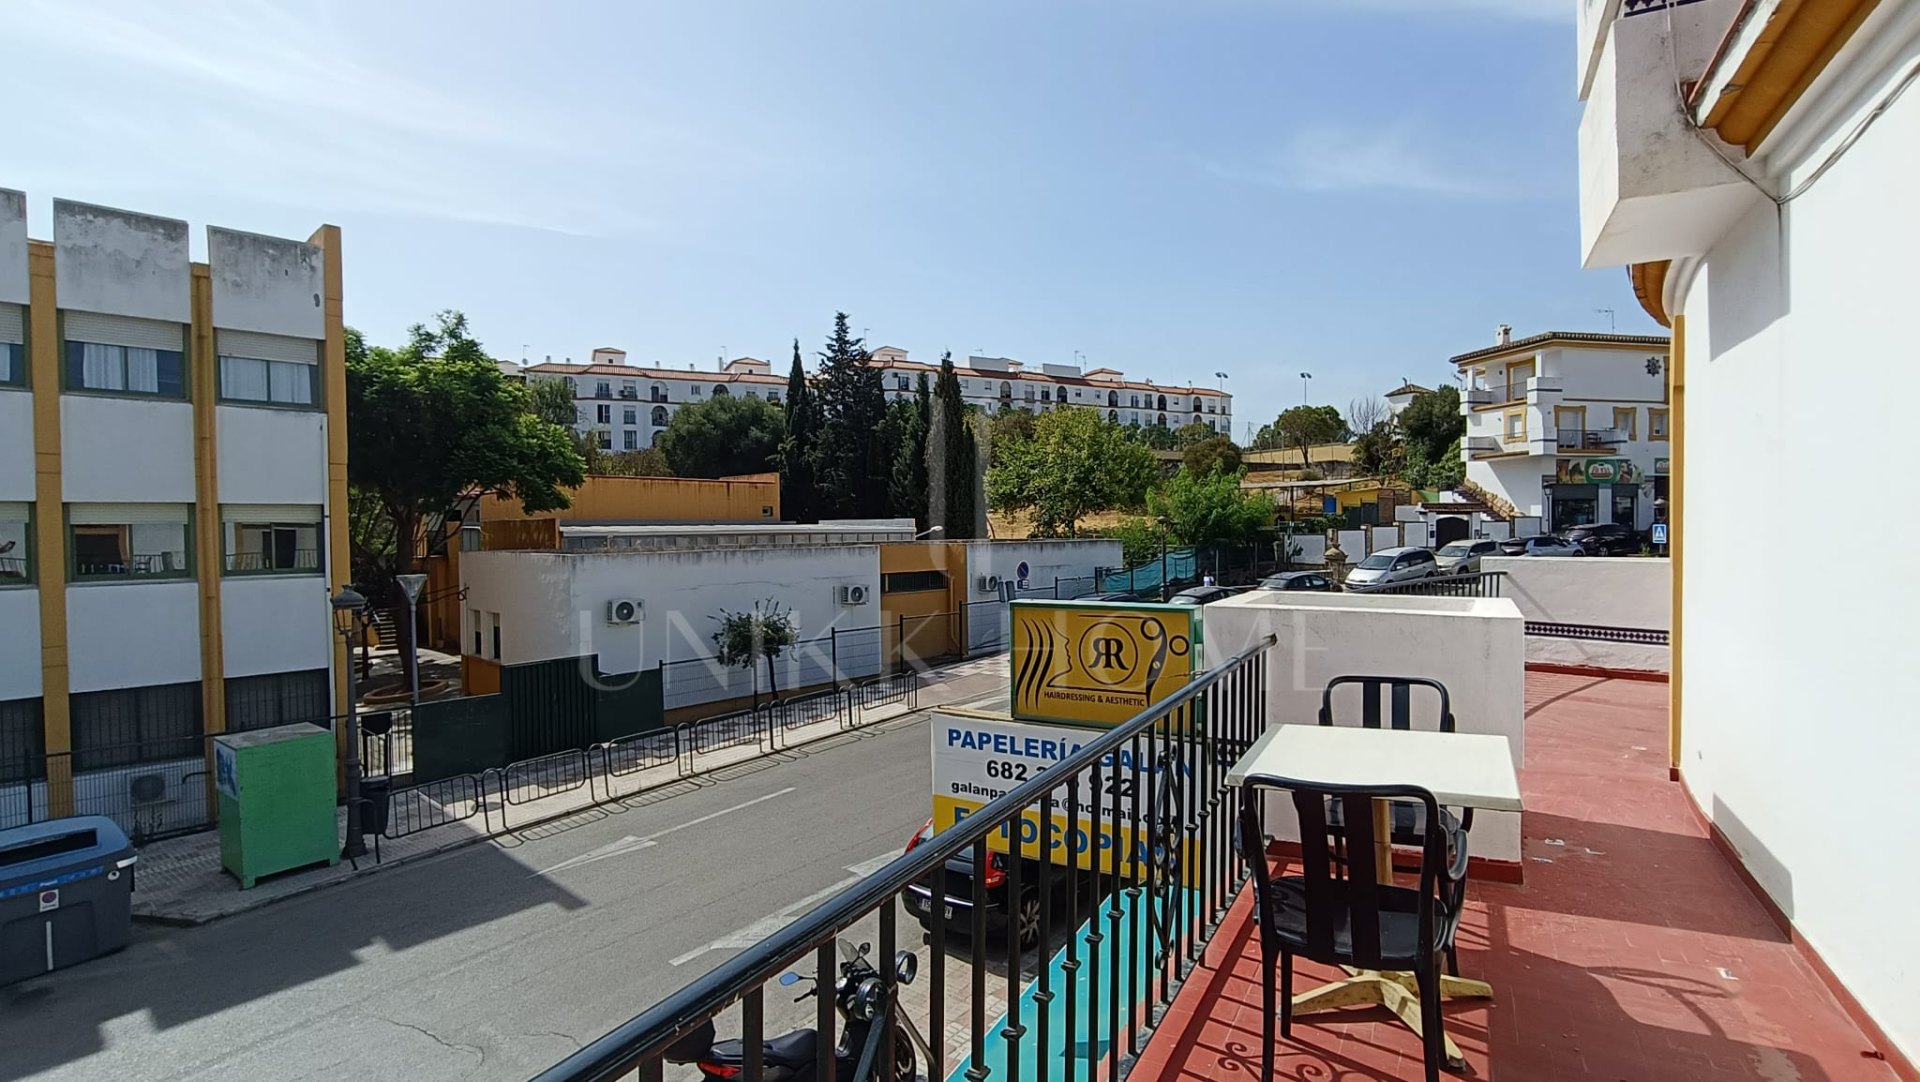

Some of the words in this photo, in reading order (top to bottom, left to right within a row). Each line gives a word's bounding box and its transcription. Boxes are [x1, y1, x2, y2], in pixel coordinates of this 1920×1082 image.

[1043, 690, 1096, 703] HAIRDRESSING
[1097, 694, 1104, 704] &
[1105, 696, 1145, 707] AESTHETIC
[986, 760, 1028, 782] 682
